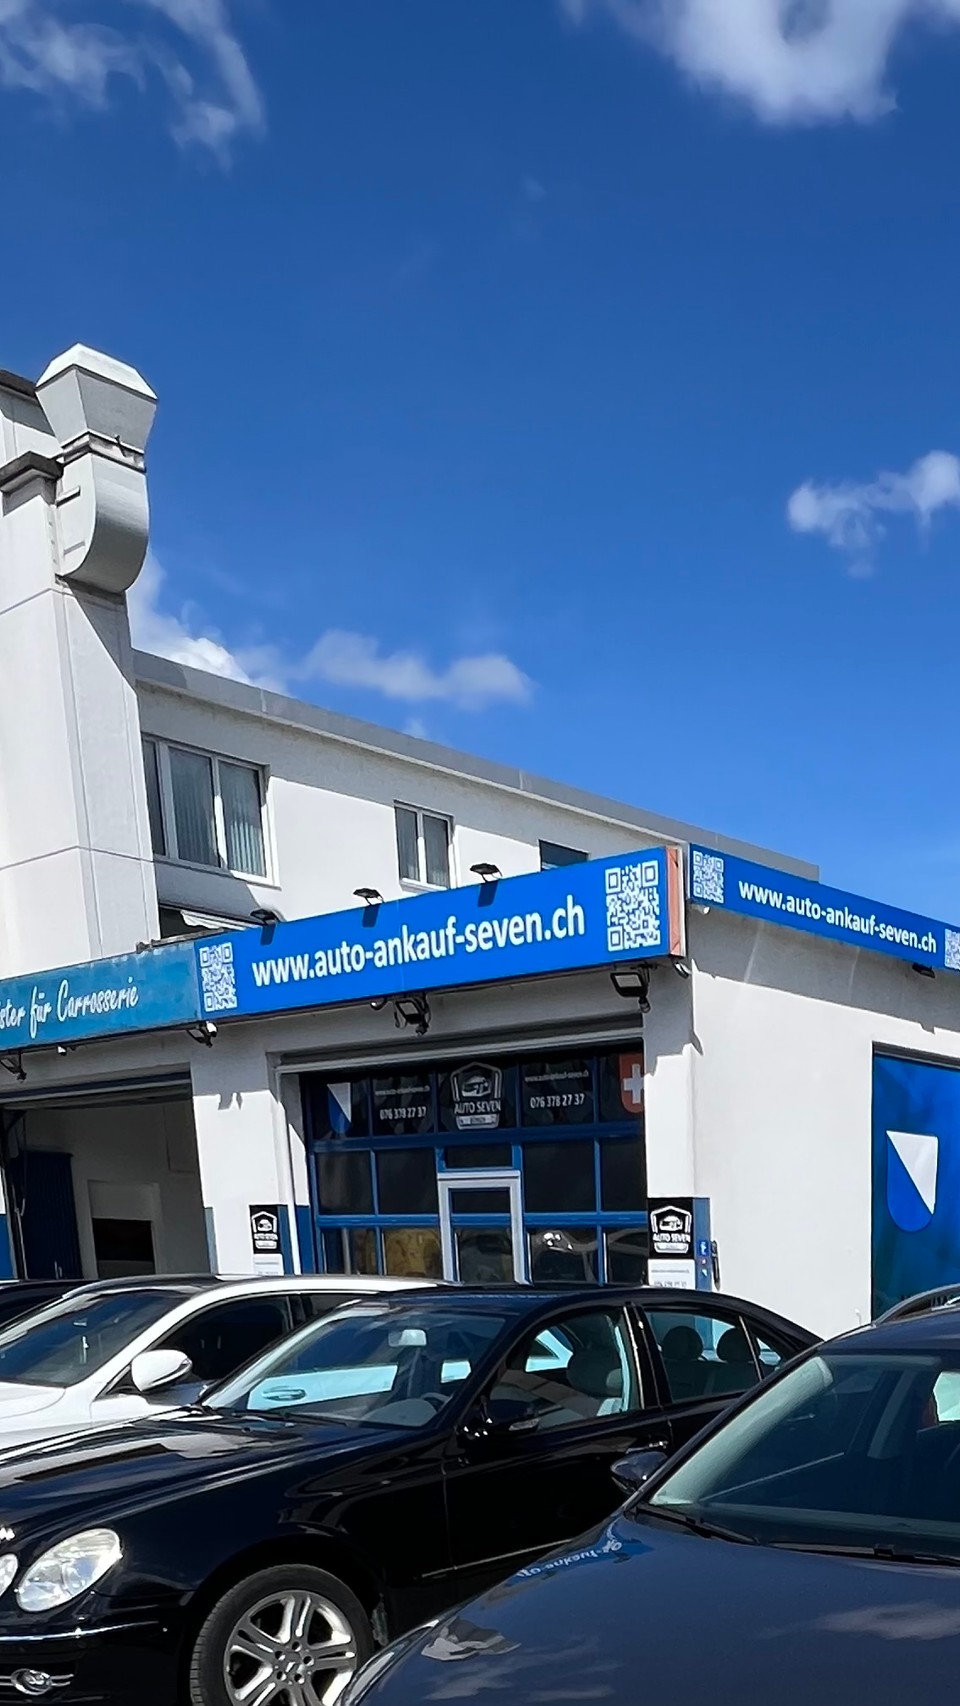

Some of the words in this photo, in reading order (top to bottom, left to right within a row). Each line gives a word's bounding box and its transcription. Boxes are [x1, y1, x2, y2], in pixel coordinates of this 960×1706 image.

[251, 894, 586, 987] www.auto-ankauf-seven.ch
[738, 880, 937, 954] www.auto-ankauf-seven.ch
[0, 998, 26, 1030] ster
[30, 985, 52, 1039] für
[57, 976, 139, 1022] Carrosserie
[454, 1102, 475, 1115] AUTO
[476, 1100, 501, 1114] SEVEN
[562, 1094, 573, 1107] 27
[574, 1093, 585, 1105] 37
